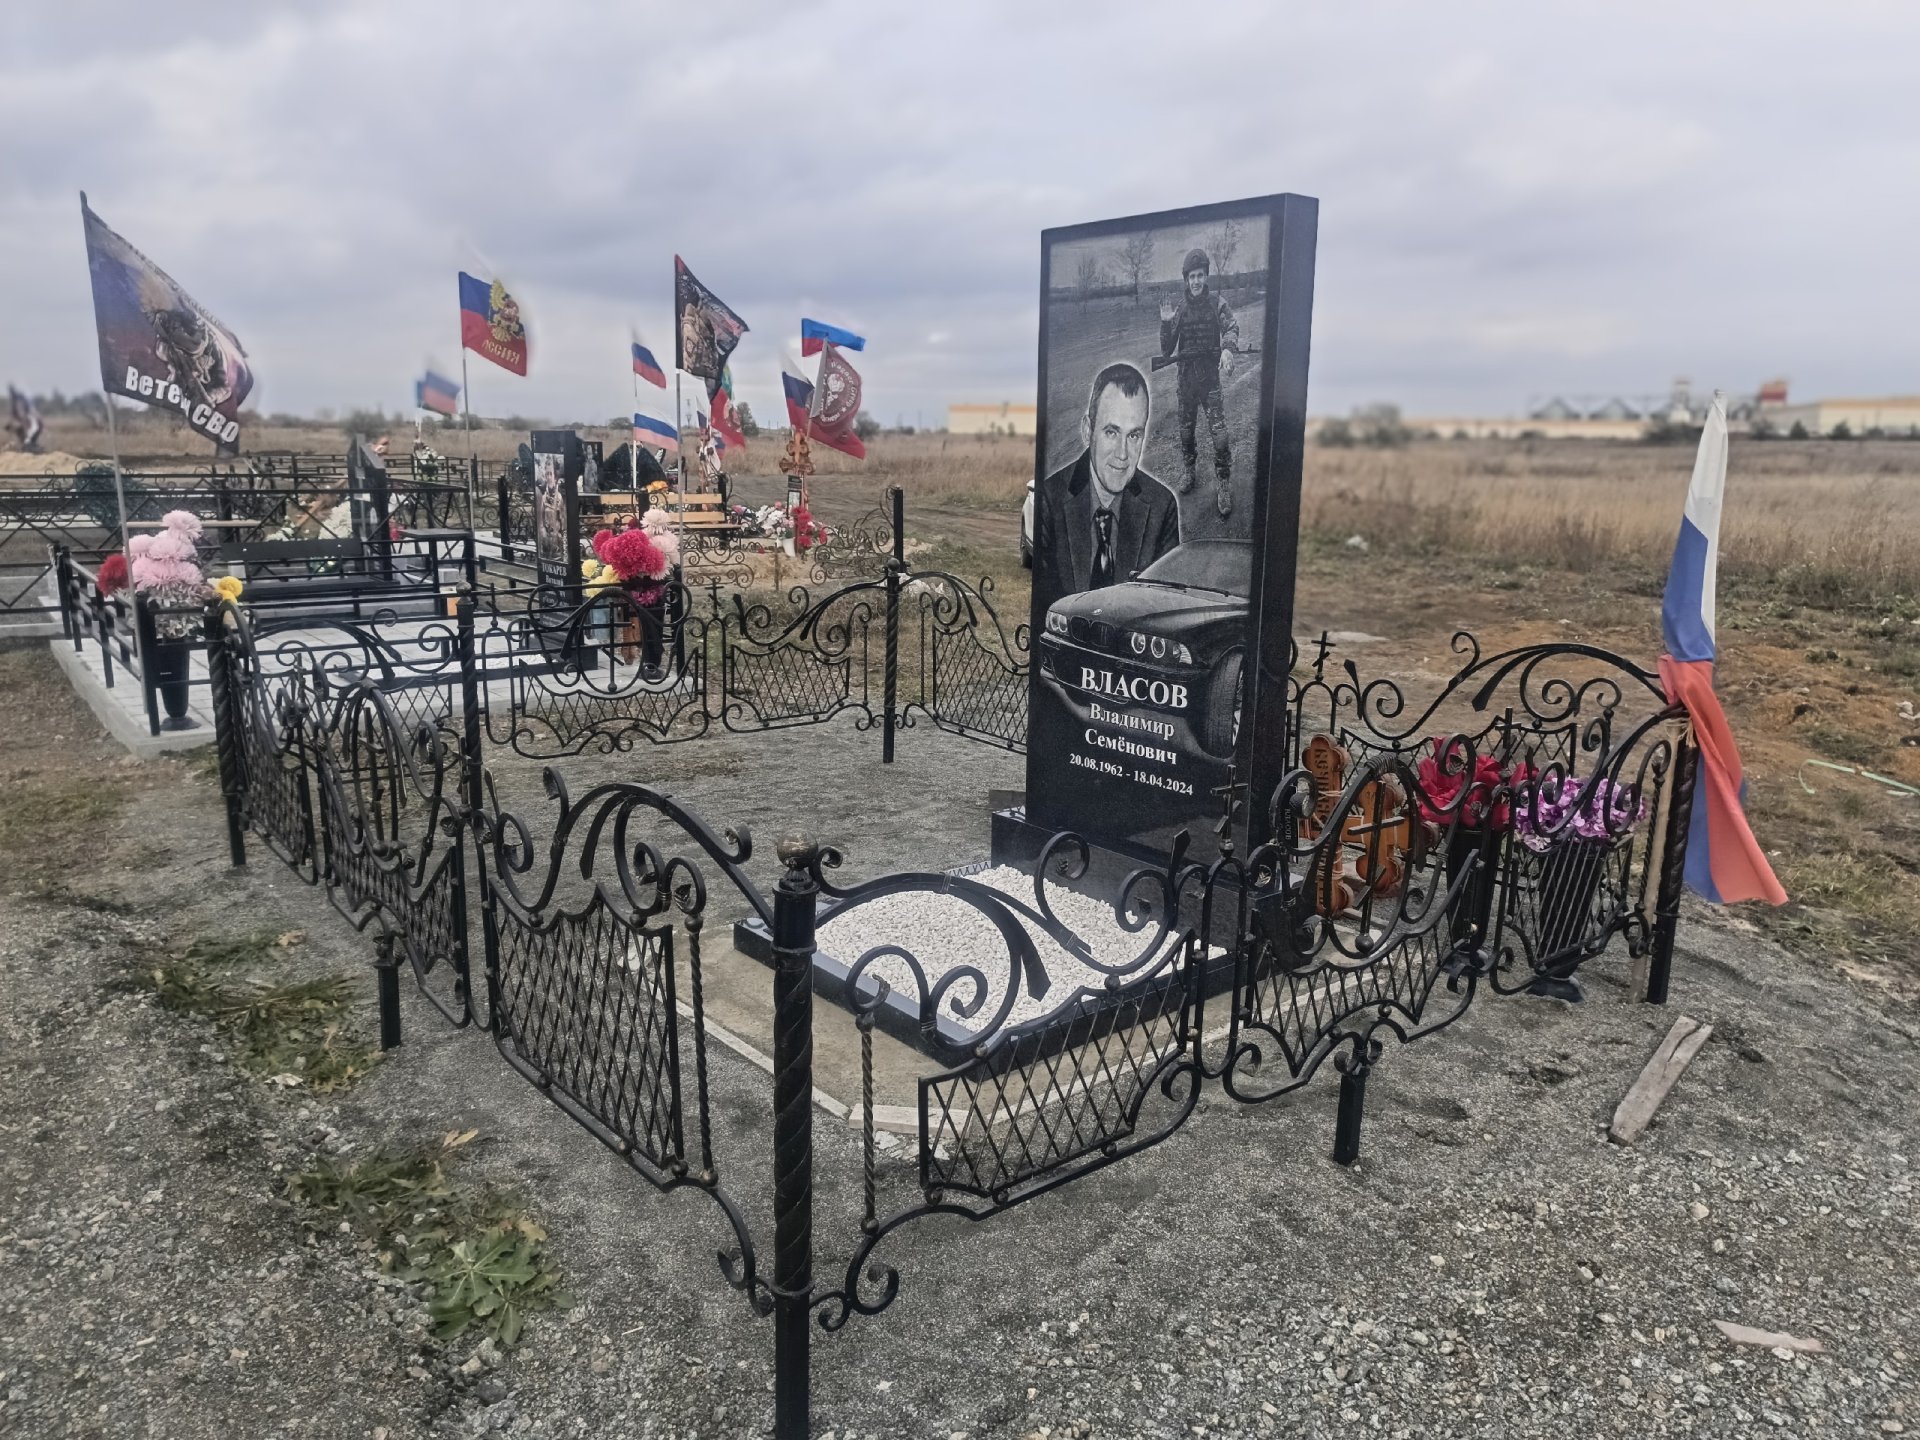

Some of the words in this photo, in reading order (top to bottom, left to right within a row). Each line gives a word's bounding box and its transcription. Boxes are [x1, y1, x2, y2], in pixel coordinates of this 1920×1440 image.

[481, 339, 520, 364] ССИЯ
[192, 403, 240, 443] СВО
[1080, 666, 1189, 709] ВЛАСОВ
[1089, 702, 1175, 742] Владимир
[1084, 728, 1177, 765] Семёнович
[1069, 753, 1123, 778] 20.08.1962
[1133, 769, 1194, 796] 18.04.2024
